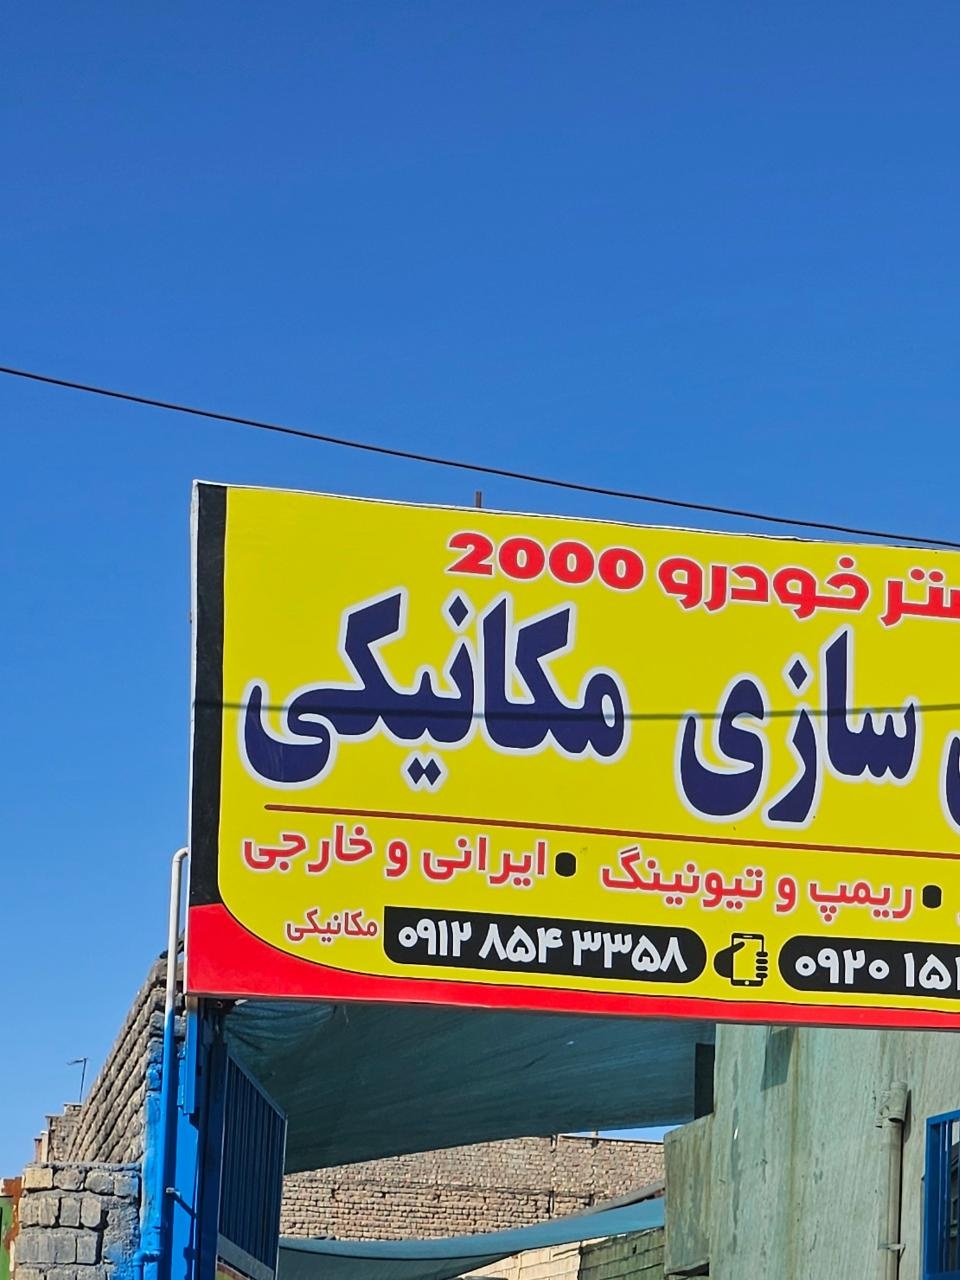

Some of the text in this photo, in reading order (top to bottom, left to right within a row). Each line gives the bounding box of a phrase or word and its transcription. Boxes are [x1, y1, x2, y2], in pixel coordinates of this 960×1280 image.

[449, 532, 644, 590] 2000
[658, 557, 870, 619] خودرو
[243, 592, 626, 785] مکانیکی
[680, 629, 918, 823] سازی
[244, 824, 547, 887] ایرانی و خارجی
[602, 847, 913, 922] ریمپ و تیونینگ
[287, 908, 378, 944] مکانیکی
[398, 918, 689, 973] ۰۹۱۲ ۸۵۴ ۳۳۵۸
[795, 948, 890, 985] ۰۹۲۰
